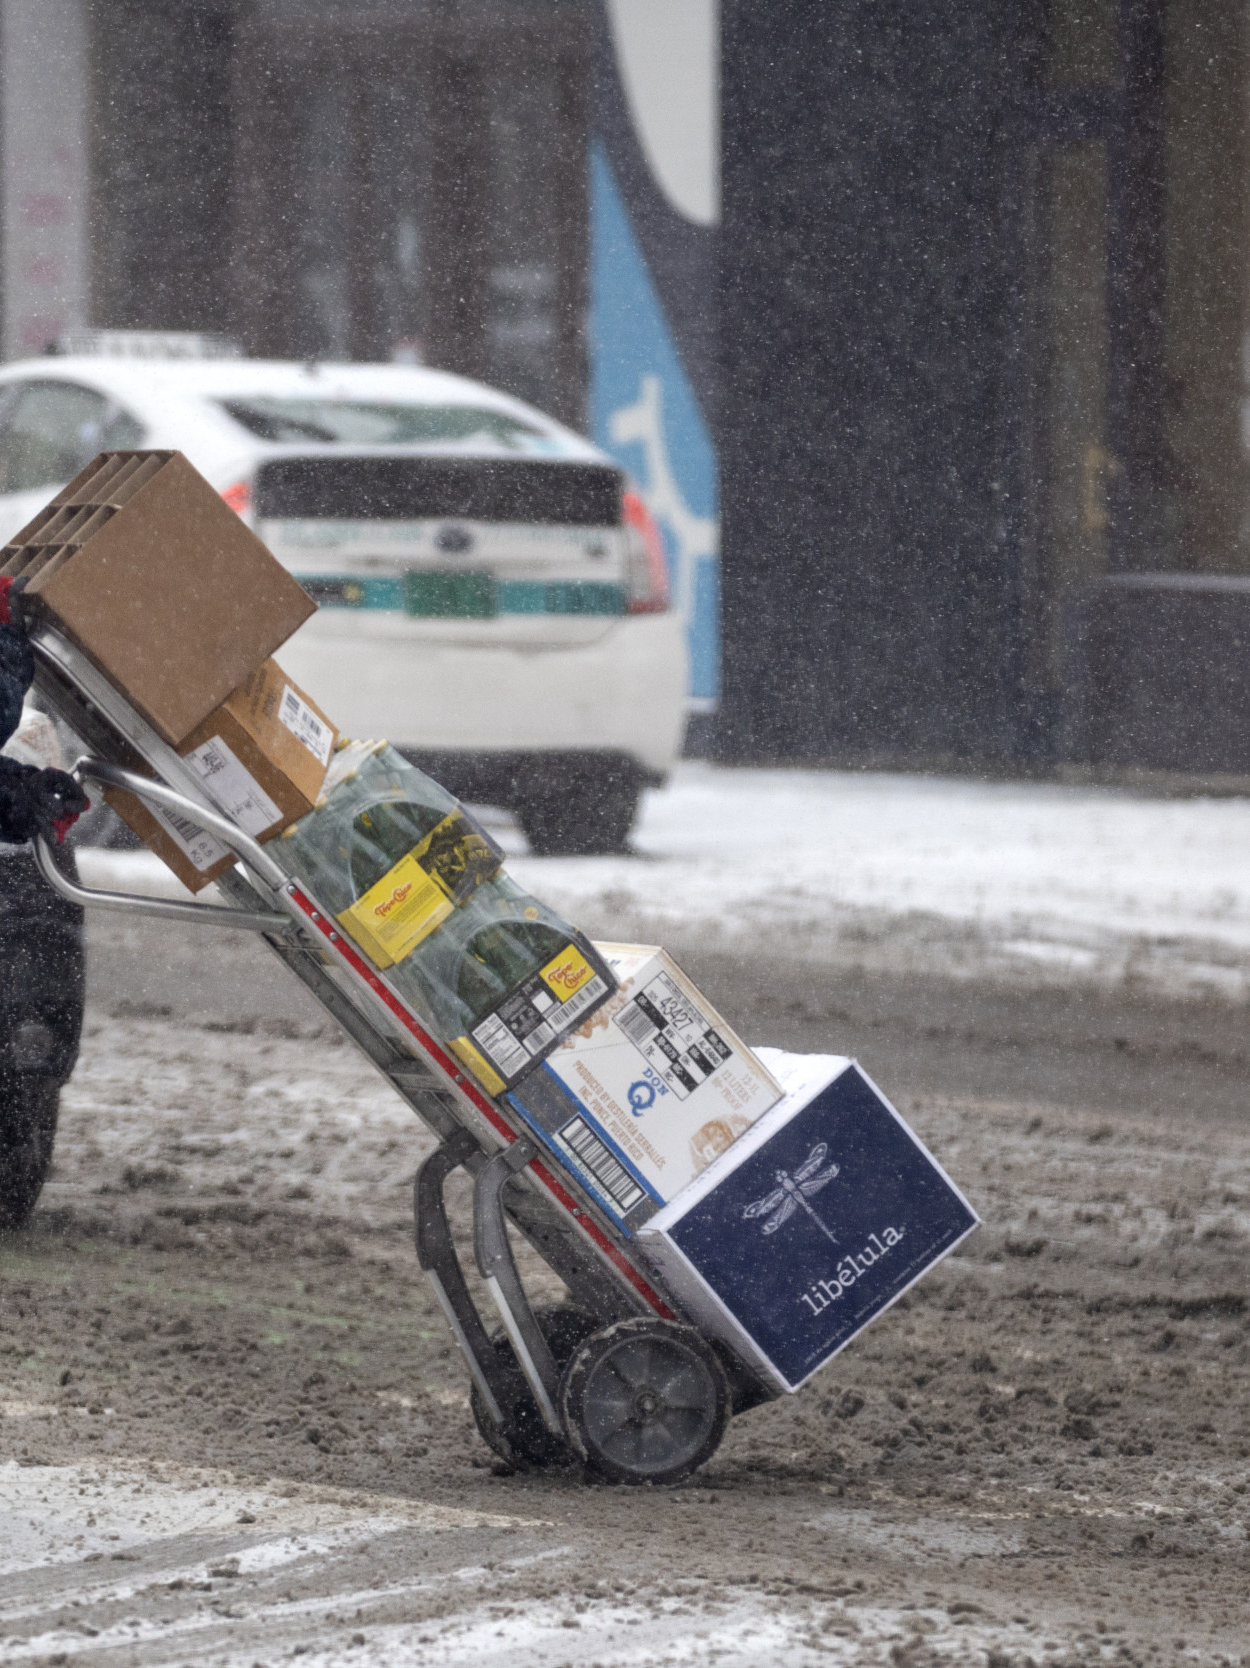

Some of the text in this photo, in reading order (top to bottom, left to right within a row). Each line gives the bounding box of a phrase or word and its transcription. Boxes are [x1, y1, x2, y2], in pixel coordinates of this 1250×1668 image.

[374, 899, 396, 917] Topo
[392, 881, 413, 903] Chico
[547, 962, 573, 985] Topo
[563, 966, 587, 989] Chico
[656, 993, 694, 1033] 43427
[571, 1058, 605, 1096] PRODUCED
[599, 1091, 612, 1104] BY
[606, 1098, 641, 1137] DESTILERÍA
[627, 1080, 656, 1117] Q
[642, 1066, 669, 1097] DON
[607, 1119, 632, 1146] PUERTO
[626, 1142, 644, 1162] RICO
[802, 1226, 903, 1316] libélula
